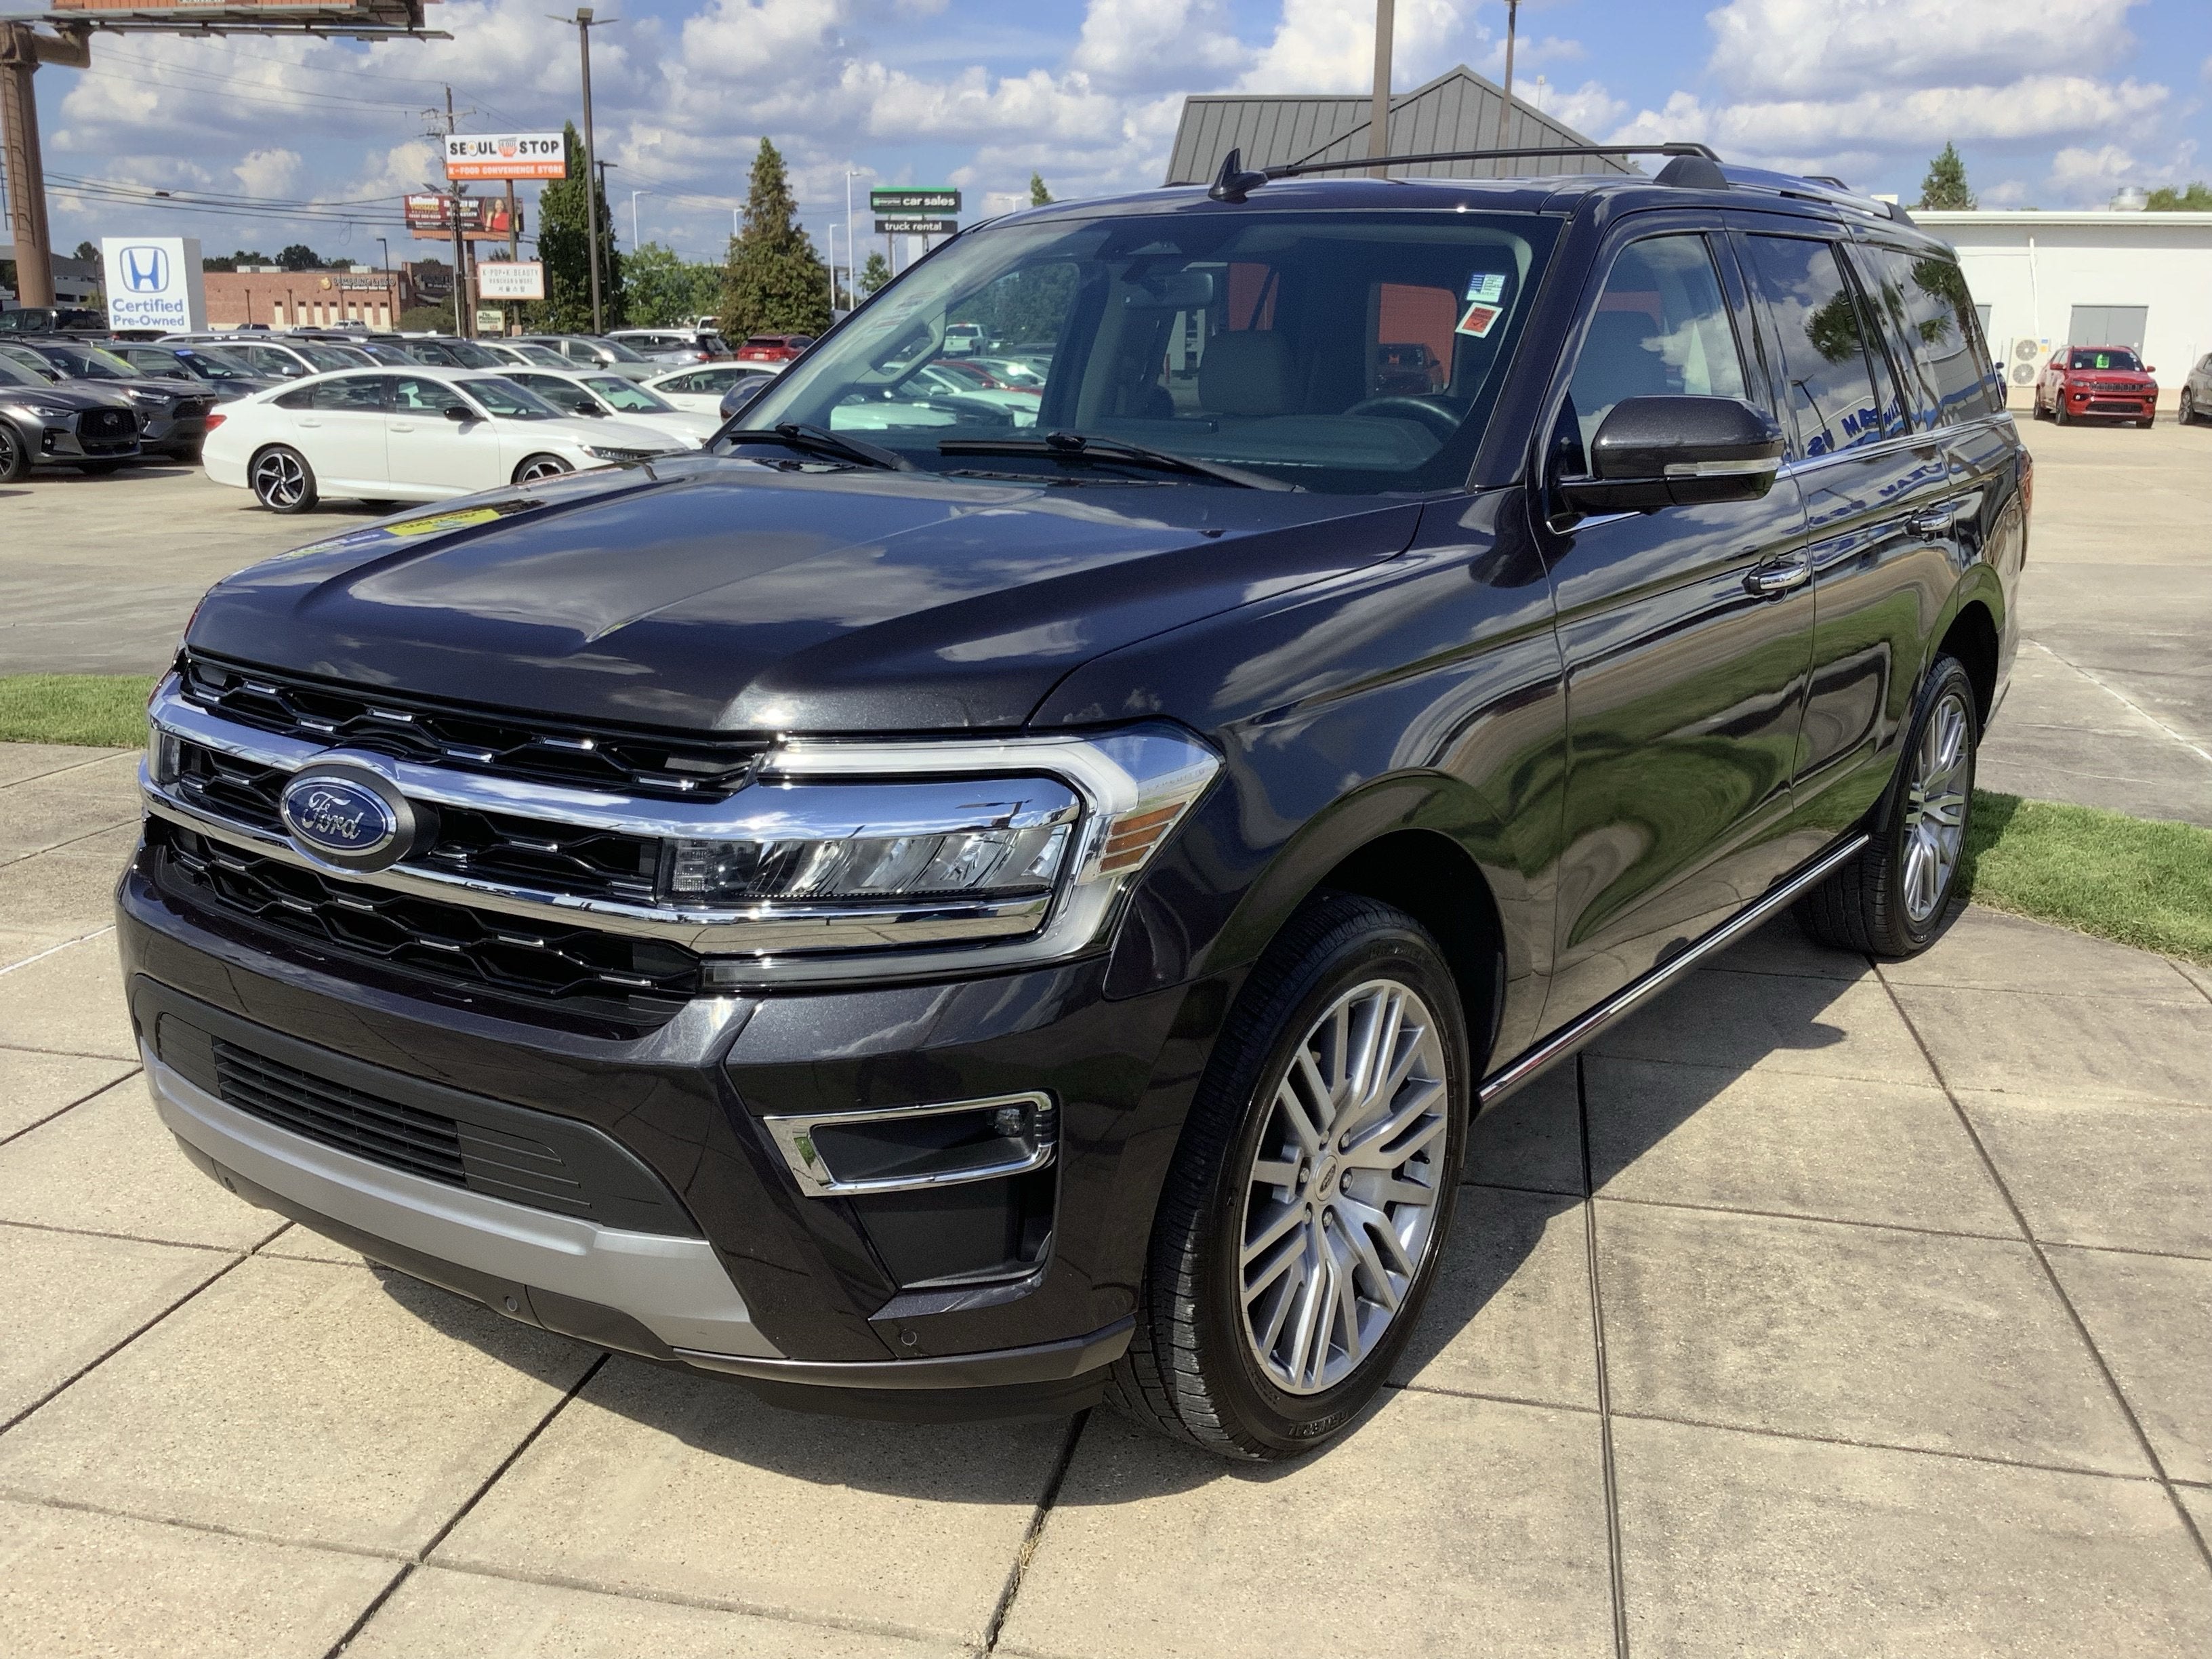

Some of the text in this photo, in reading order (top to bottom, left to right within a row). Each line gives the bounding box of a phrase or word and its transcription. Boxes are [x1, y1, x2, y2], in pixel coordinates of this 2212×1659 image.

[519, 140, 559, 155] STOP
[483, 165, 535, 175] CONVENIENCE
[537, 165, 563, 174] STORE
[903, 197, 922, 206] car
[924, 195, 956, 206] sales
[884, 221, 942, 231] truck rental
[112, 298, 184, 312] Certified
[113, 314, 184, 326] Pre-Owned
[302, 791, 365, 840] Ford
